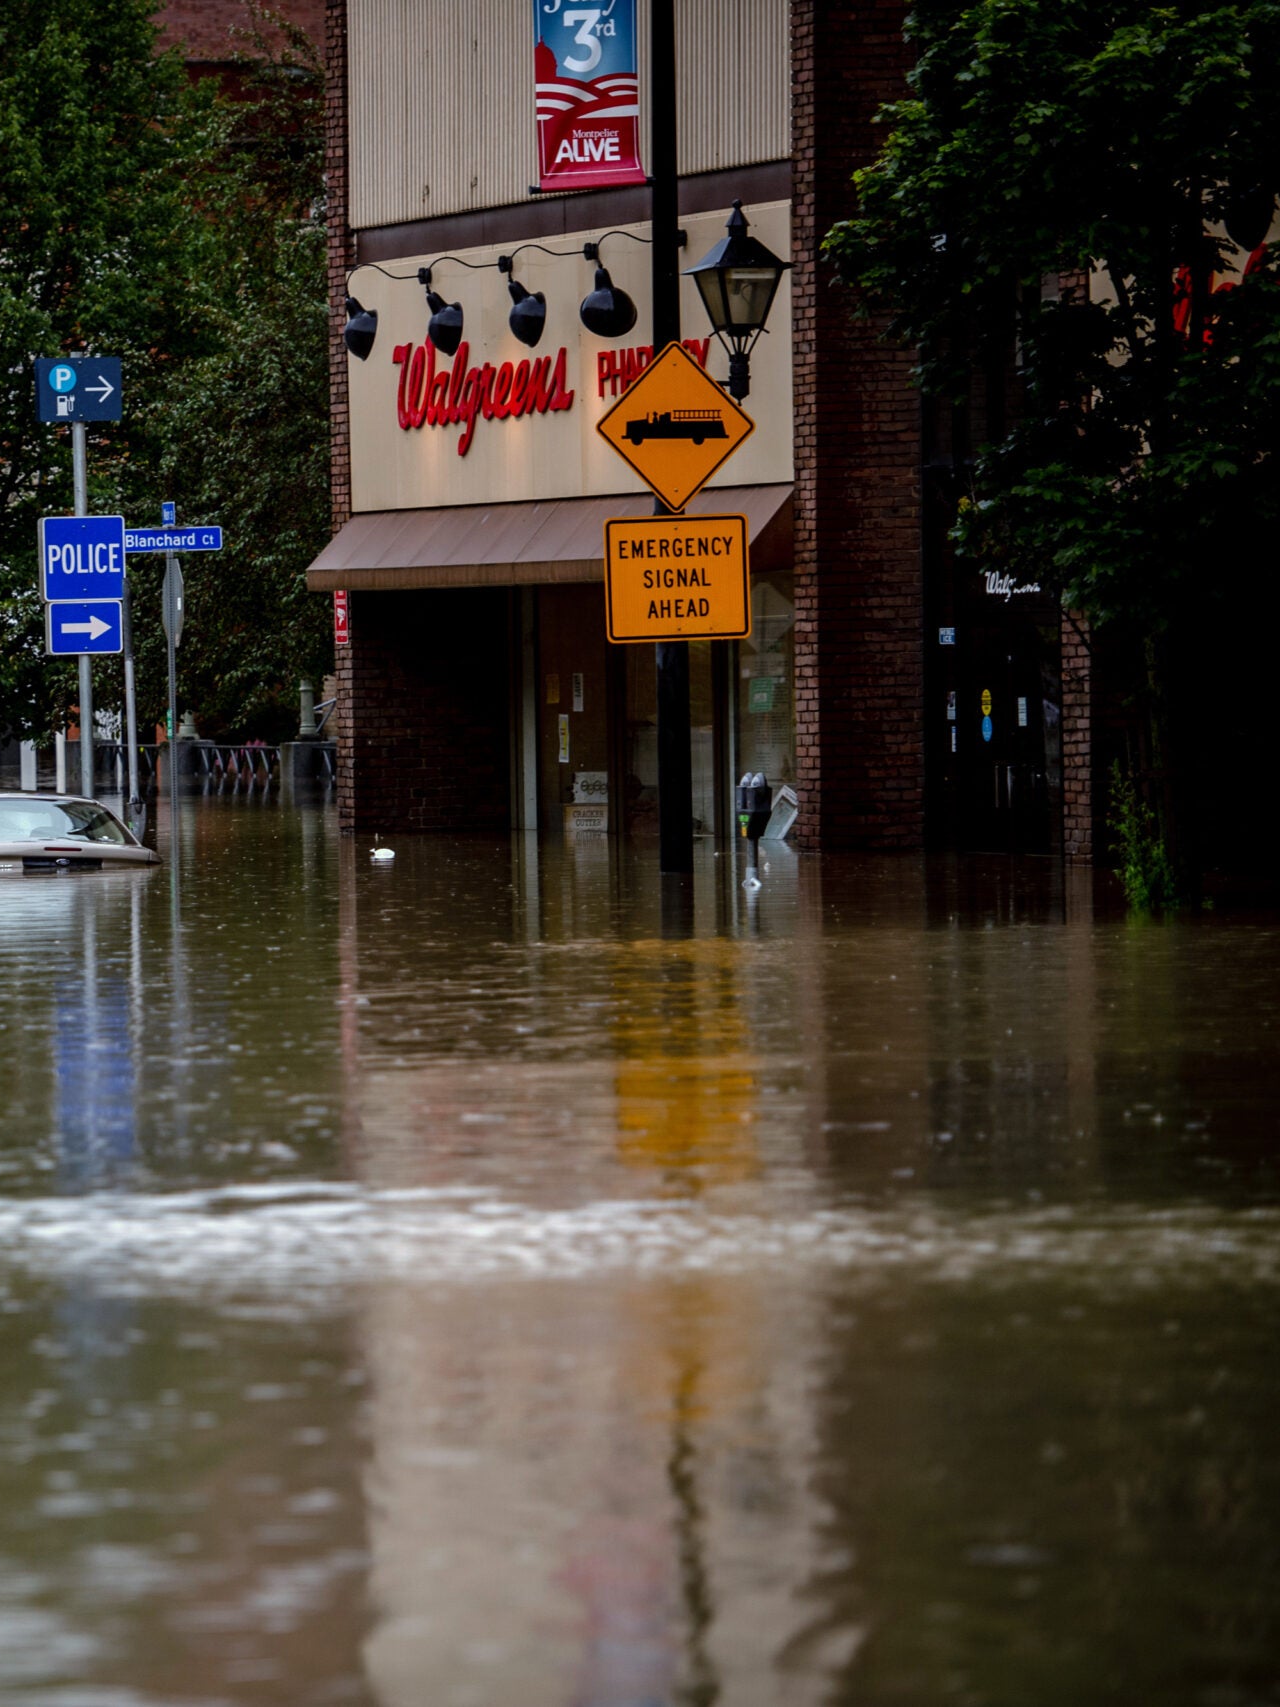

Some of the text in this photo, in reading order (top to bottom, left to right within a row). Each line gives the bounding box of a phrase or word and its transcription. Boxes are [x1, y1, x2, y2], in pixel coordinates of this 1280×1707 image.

[572, 128, 619, 140] Montpelier
[392, 333, 575, 457] Walgreens
[125, 532, 215, 548] Blanchard Ct
[618, 536, 733, 559] EMERGENCY
[47, 543, 121, 575] POLICE
[643, 567, 712, 589] SIGNAL
[647, 598, 710, 619] AHEAD
